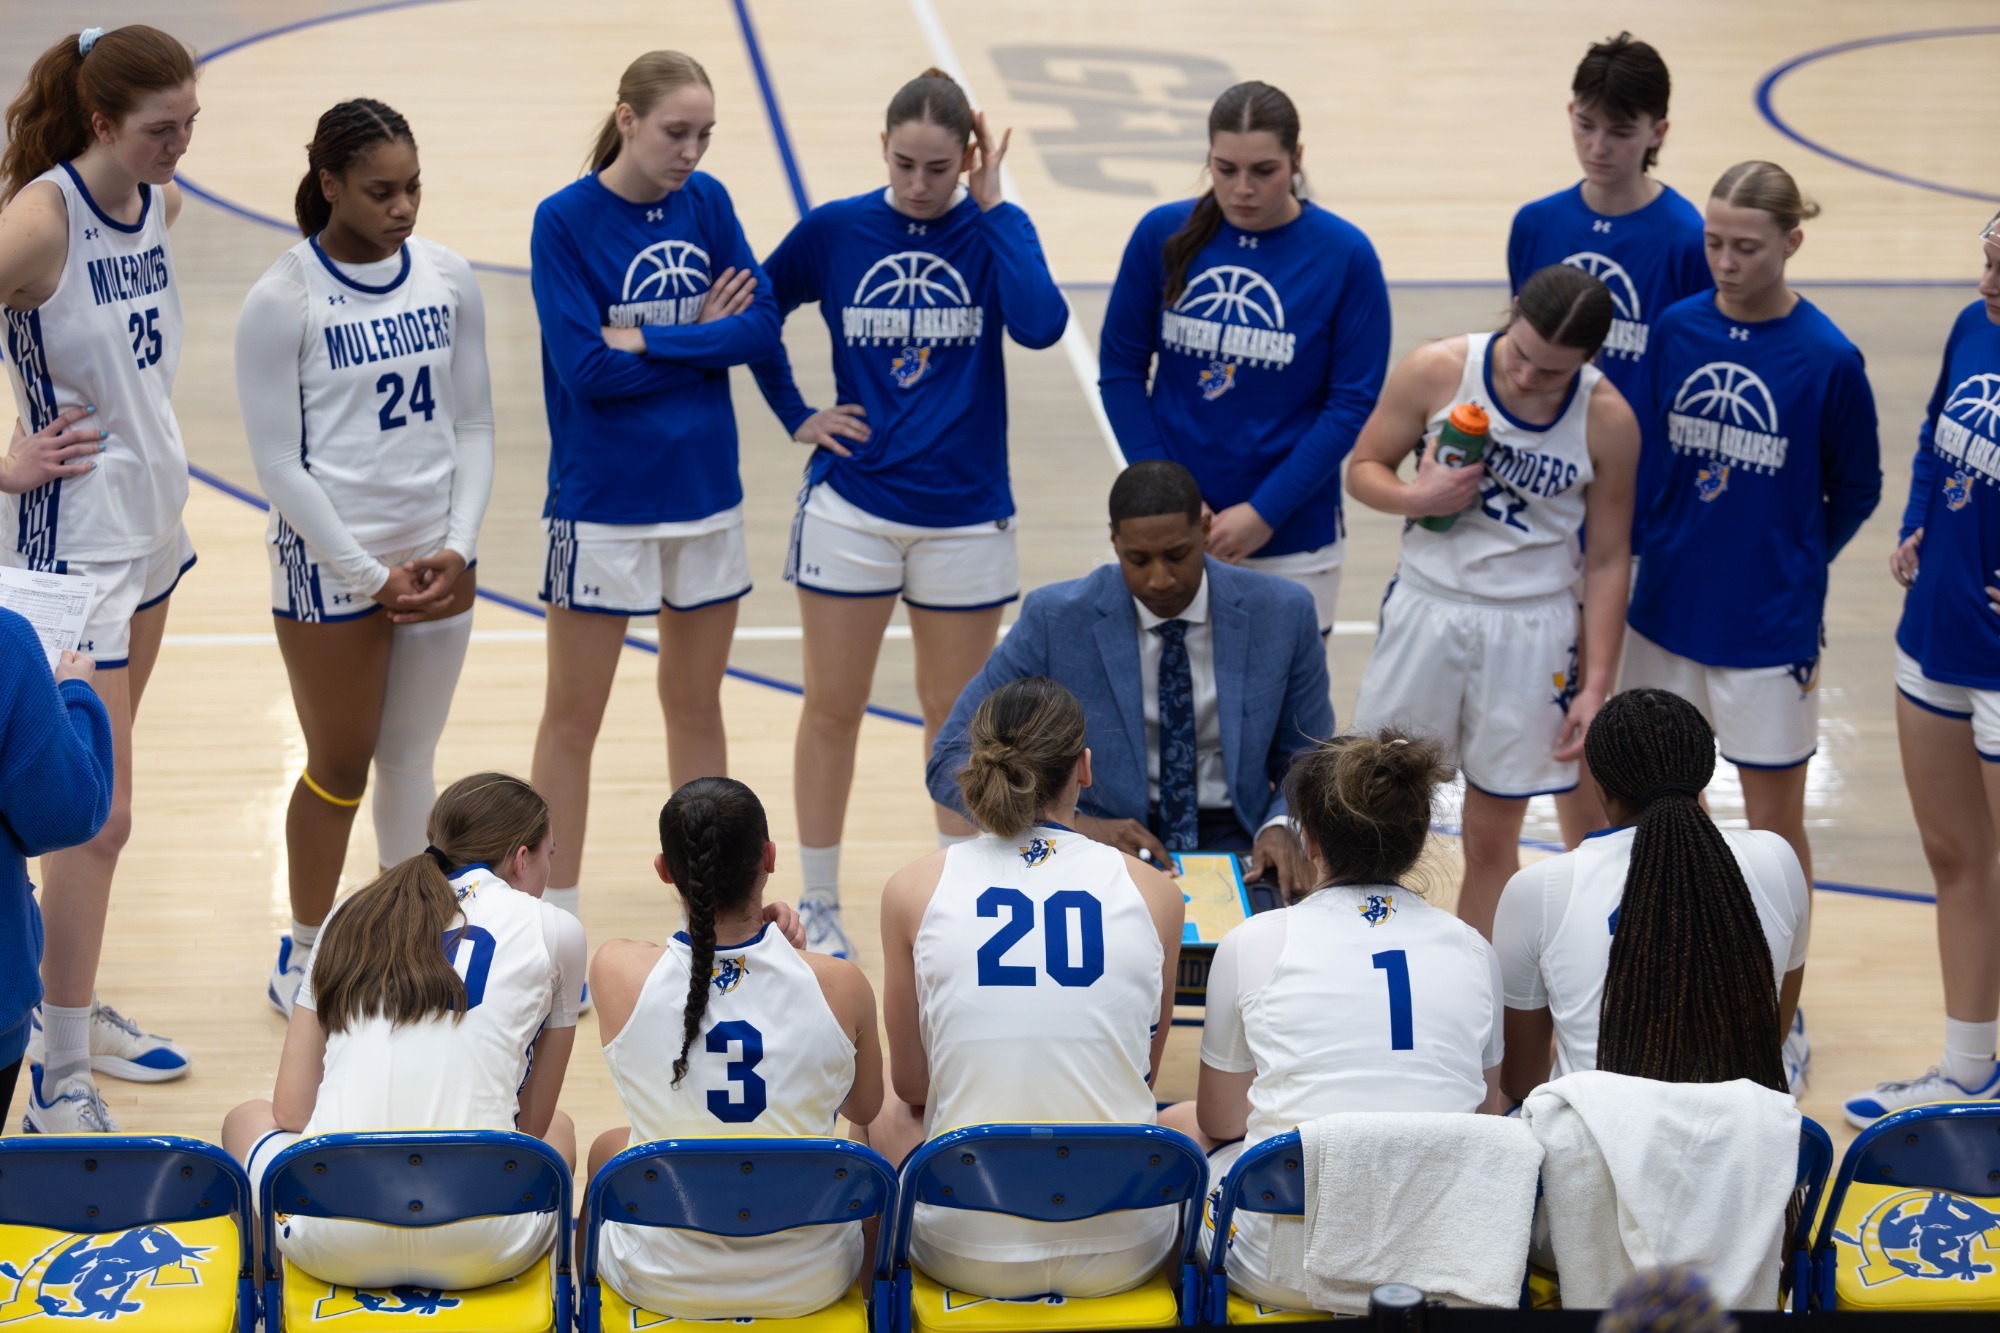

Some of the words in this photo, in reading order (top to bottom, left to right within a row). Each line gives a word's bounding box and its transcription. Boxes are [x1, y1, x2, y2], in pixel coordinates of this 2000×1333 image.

[129, 306, 162, 371] 25
[324, 304, 450, 370] MULERIDERS
[913, 306, 984, 338] ARKANSAS
[1220, 323, 1296, 365] ARKANSAS
[376, 364, 436, 432] 24
[1719, 423, 1788, 469] ARKANSAS
[976, 886, 1105, 987] 20
[1372, 949, 1414, 1051] 1
[705, 1020, 767, 1124] 3
